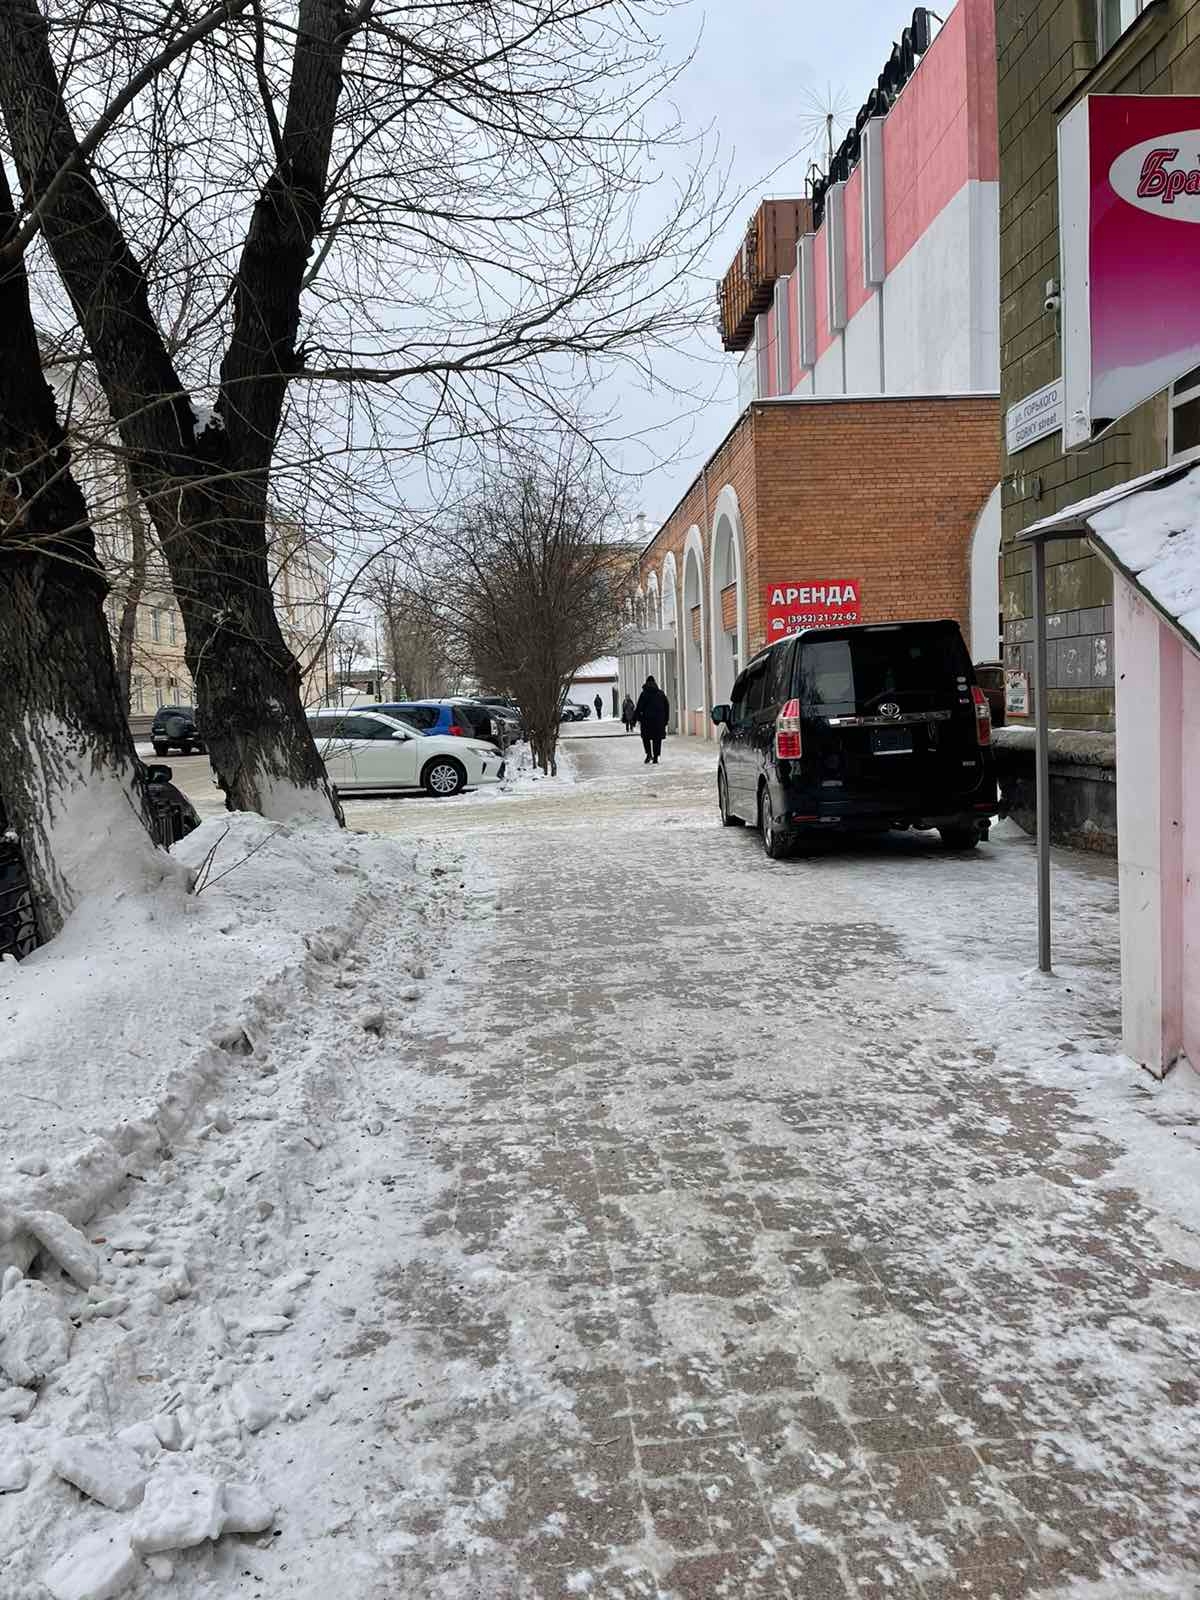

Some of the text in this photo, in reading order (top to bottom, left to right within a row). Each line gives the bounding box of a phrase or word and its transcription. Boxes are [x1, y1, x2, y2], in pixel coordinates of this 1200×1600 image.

[771, 586, 857, 606] АРЕНДА
[788, 612, 857, 624] (3952) 21-72-62
